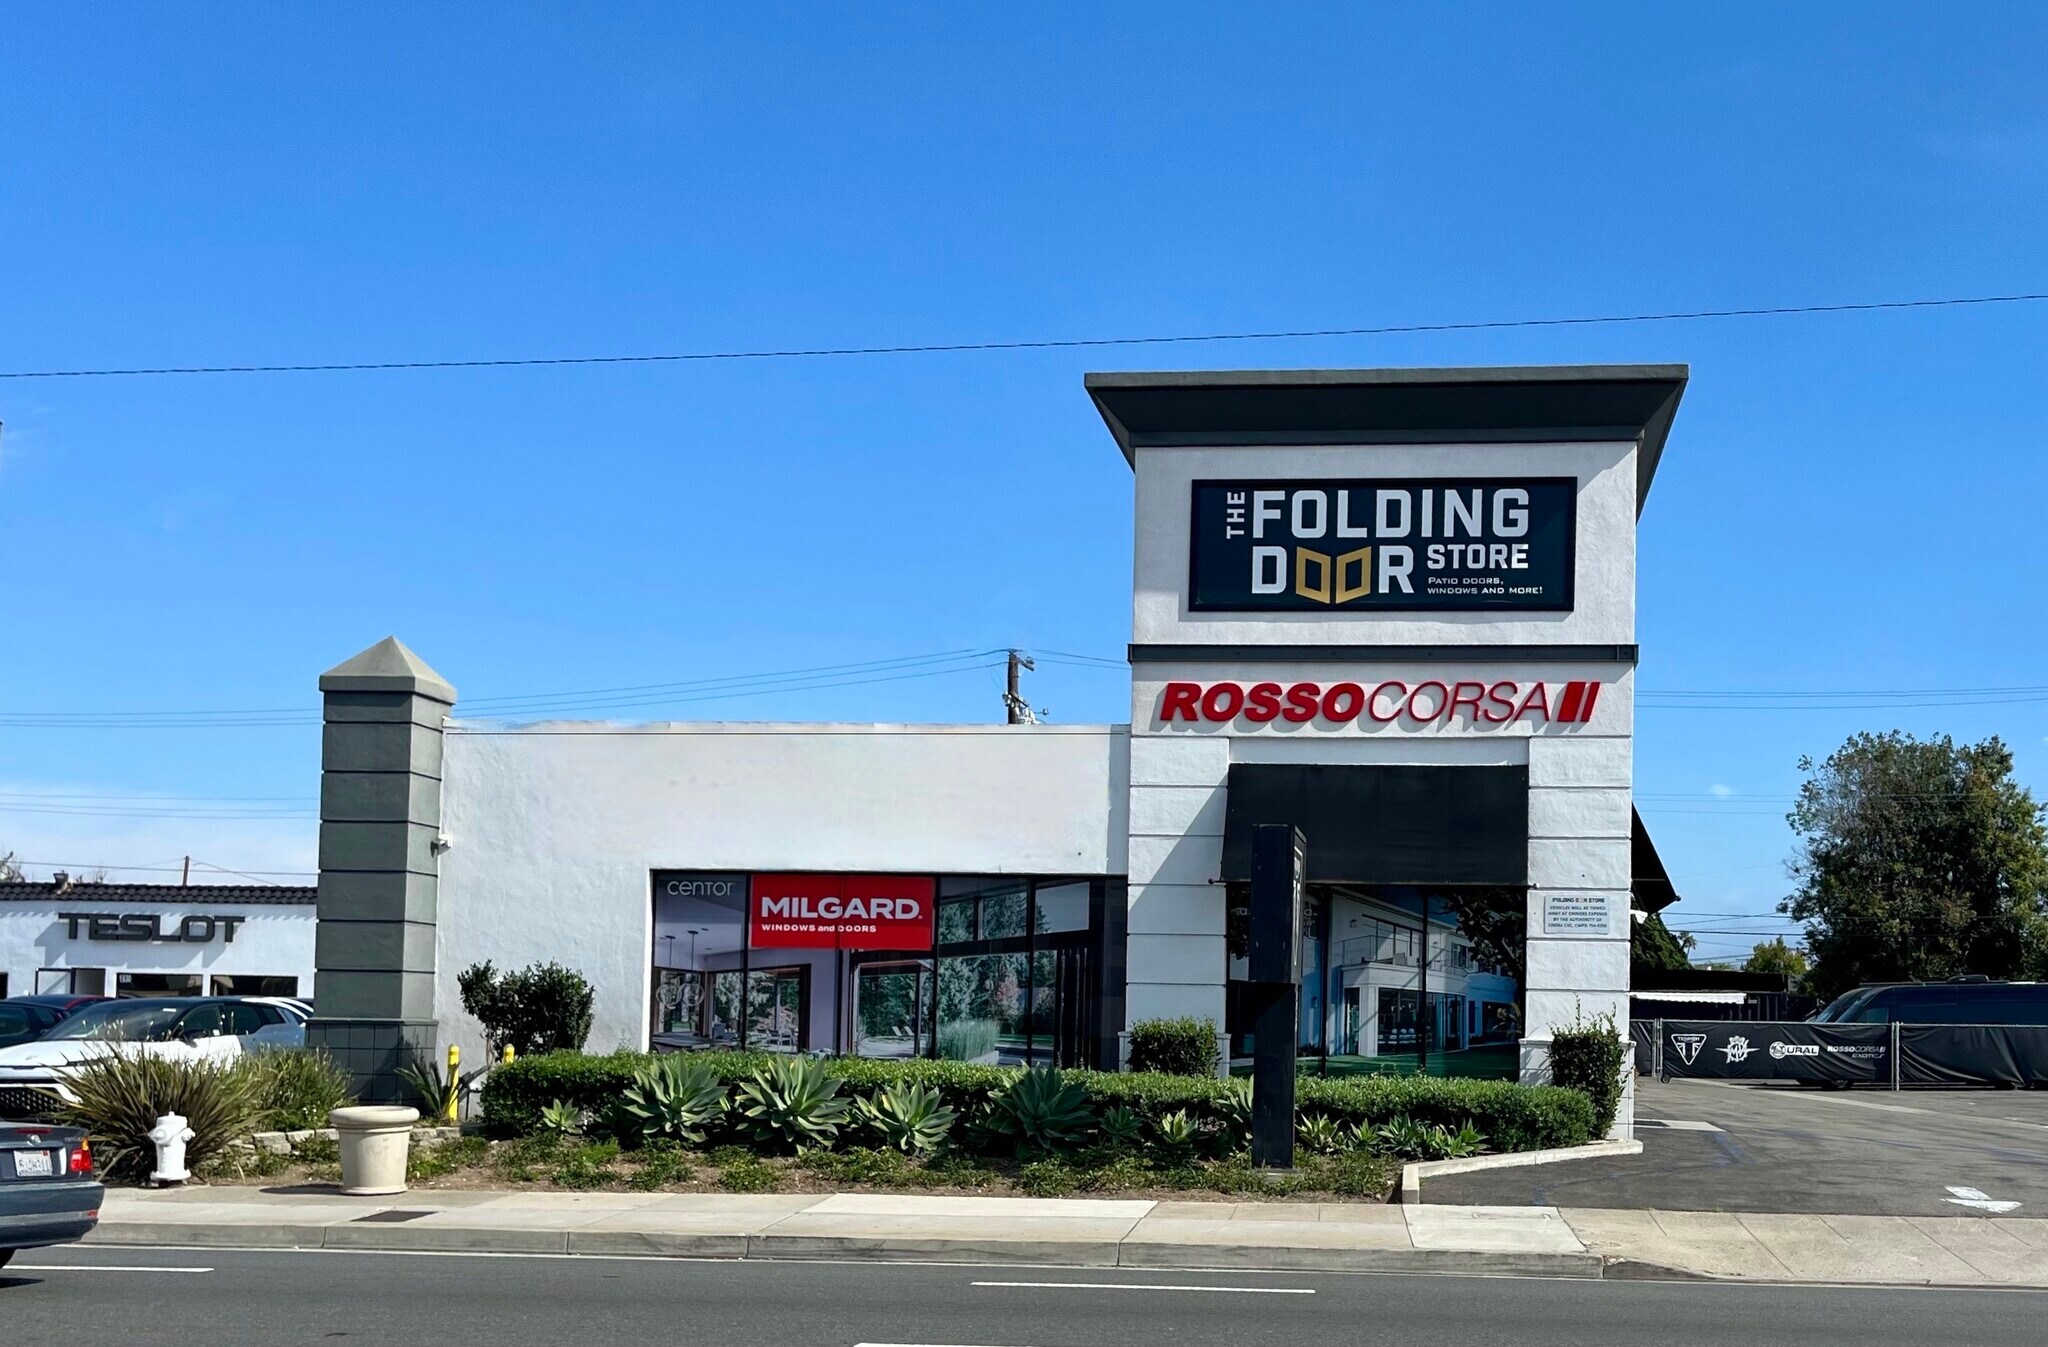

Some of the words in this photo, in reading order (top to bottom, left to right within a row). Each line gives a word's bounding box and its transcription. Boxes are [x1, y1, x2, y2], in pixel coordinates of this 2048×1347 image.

[1226, 492, 1245, 539] THE
[1252, 488, 1529, 538] FOLDING
[1427, 544, 1529, 569] STORE
[1252, 545, 1414, 605] DOOR
[1462, 577, 1504, 586] DOORS,
[1509, 586, 1543, 594] MORE!
[1160, 682, 1550, 722] ROSSOCORSA
[761, 896, 920, 919] MILGARD
[58, 912, 245, 943] TESLOT
[761, 924, 816, 932] WINDOWS
[838, 925, 876, 933] DOORS
[1787, 1046, 1818, 1054] URAL
